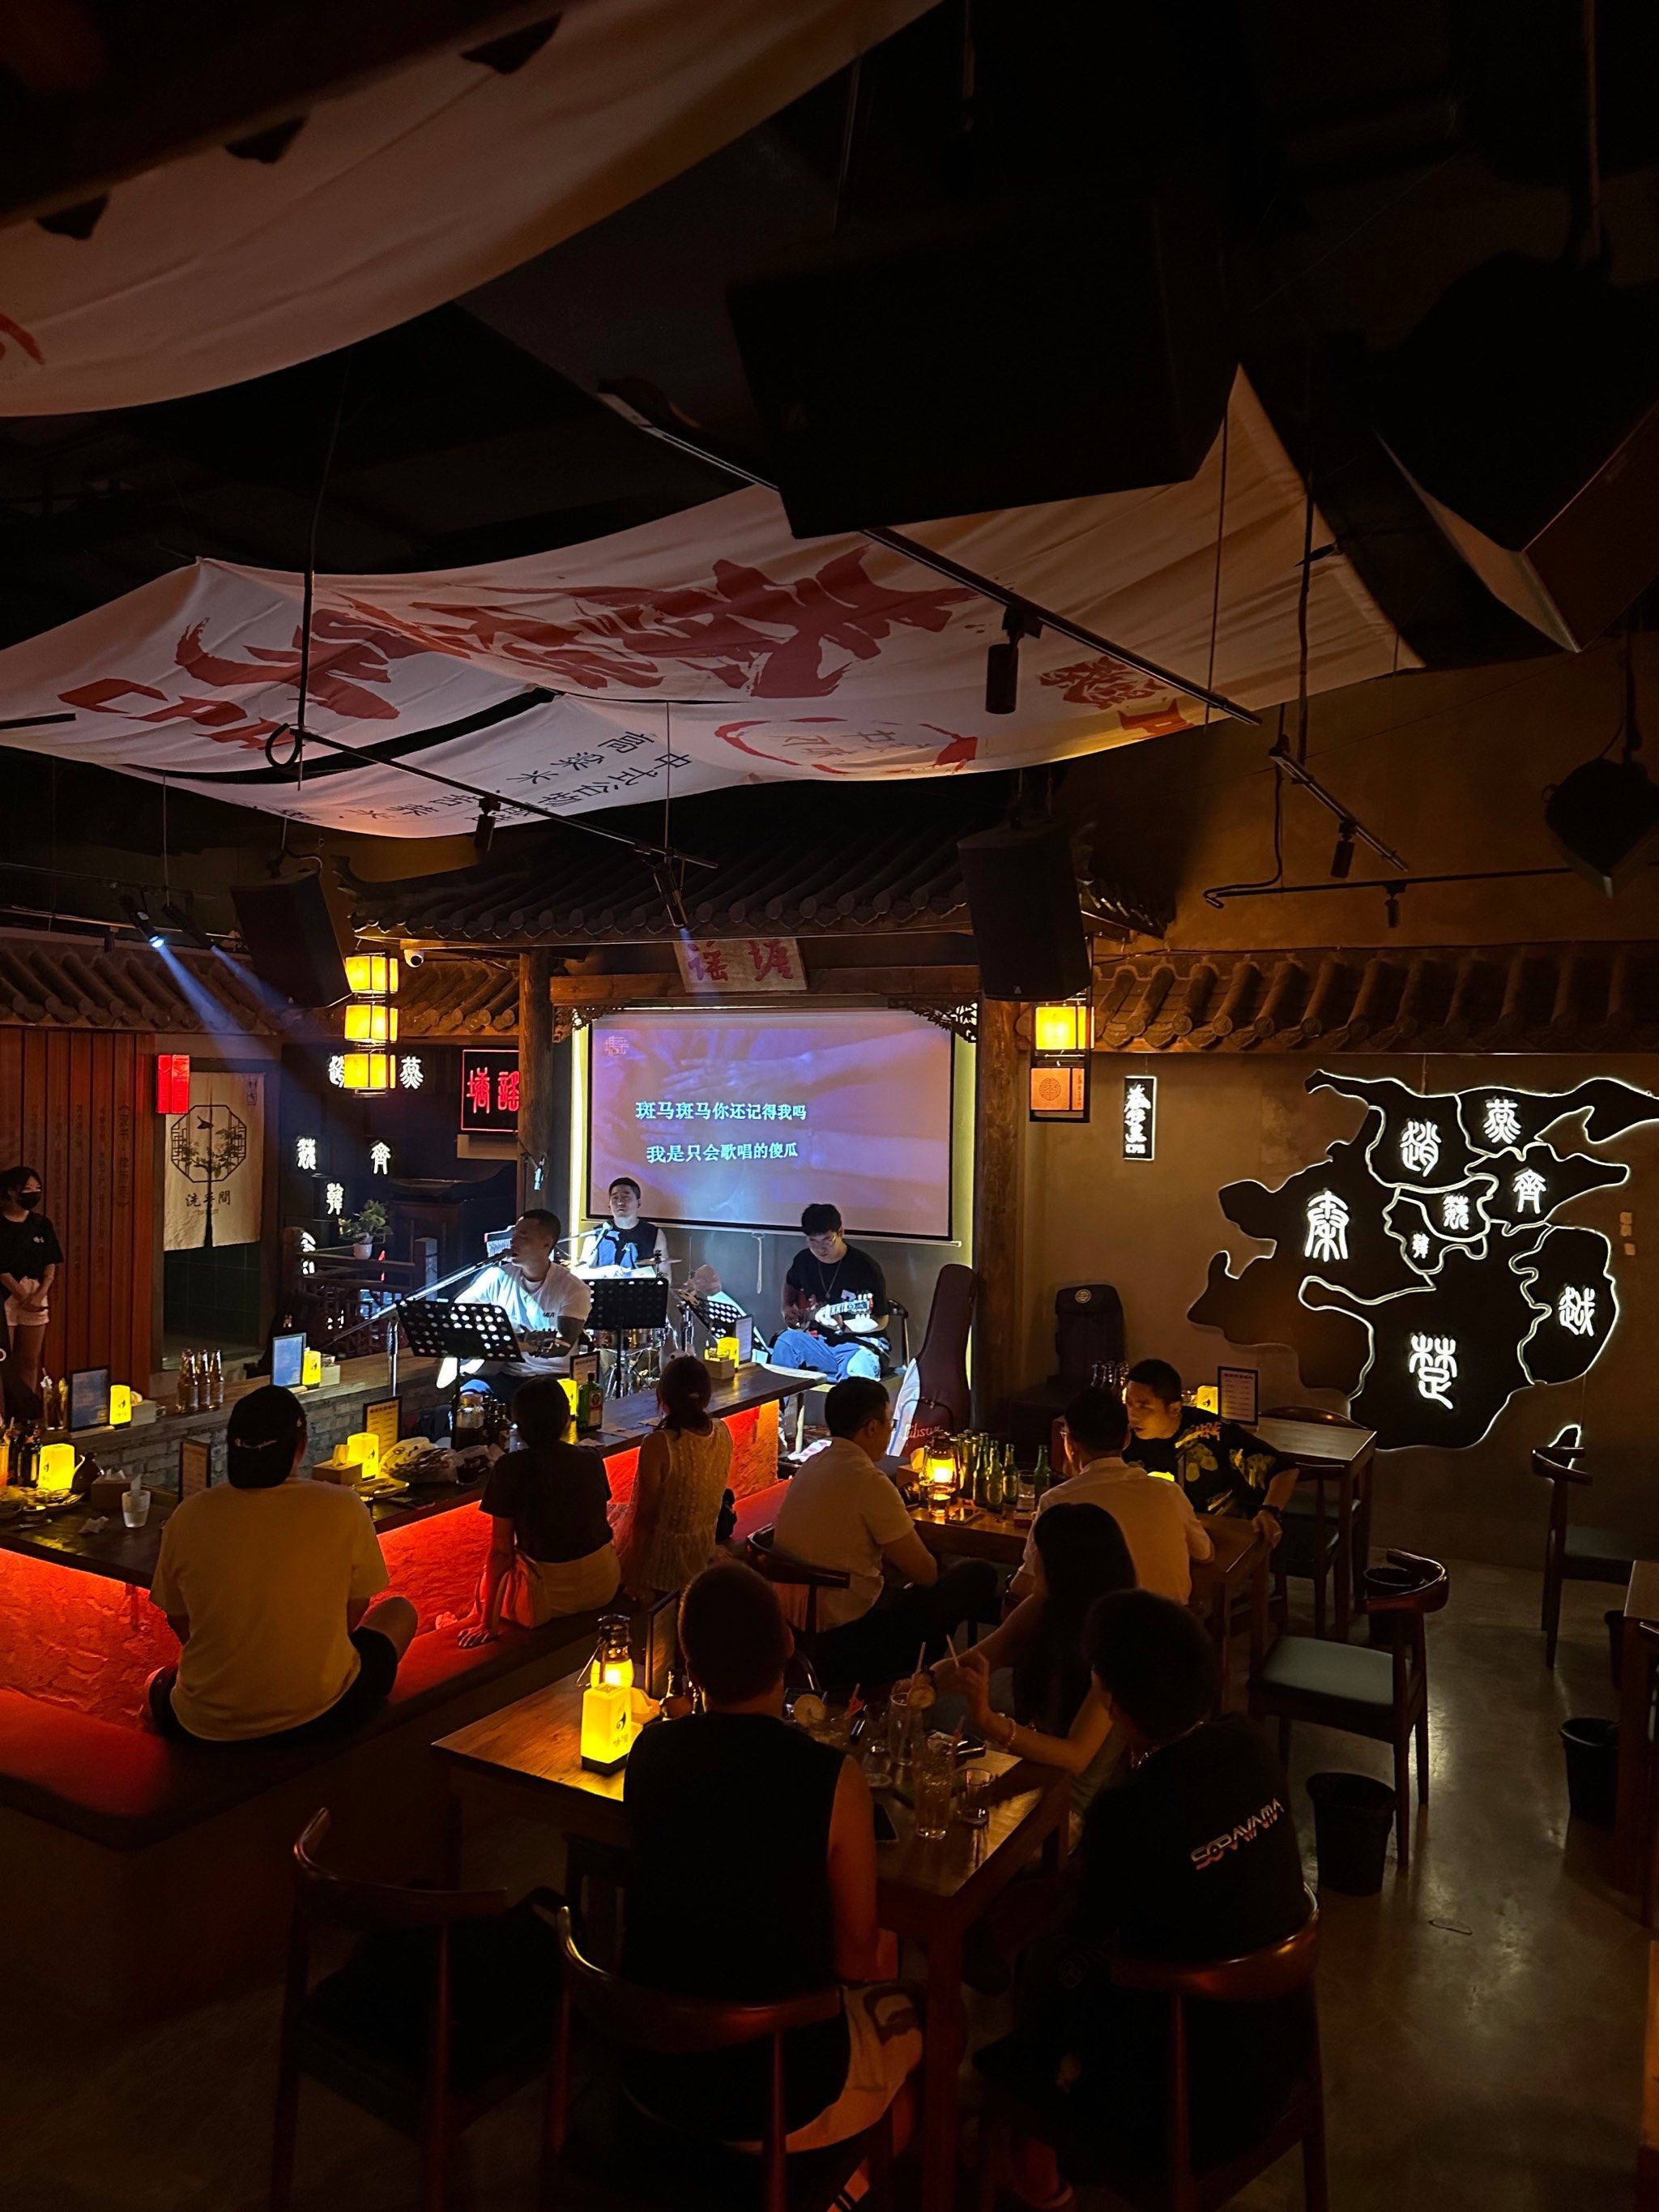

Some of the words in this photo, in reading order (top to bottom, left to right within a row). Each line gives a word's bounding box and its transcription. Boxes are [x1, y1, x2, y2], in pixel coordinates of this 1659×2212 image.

[635, 1100, 807, 1121] 斑马斑马你还记得我吗
[646, 1142, 799, 1164] 我是只会歌唱的傻瓜
